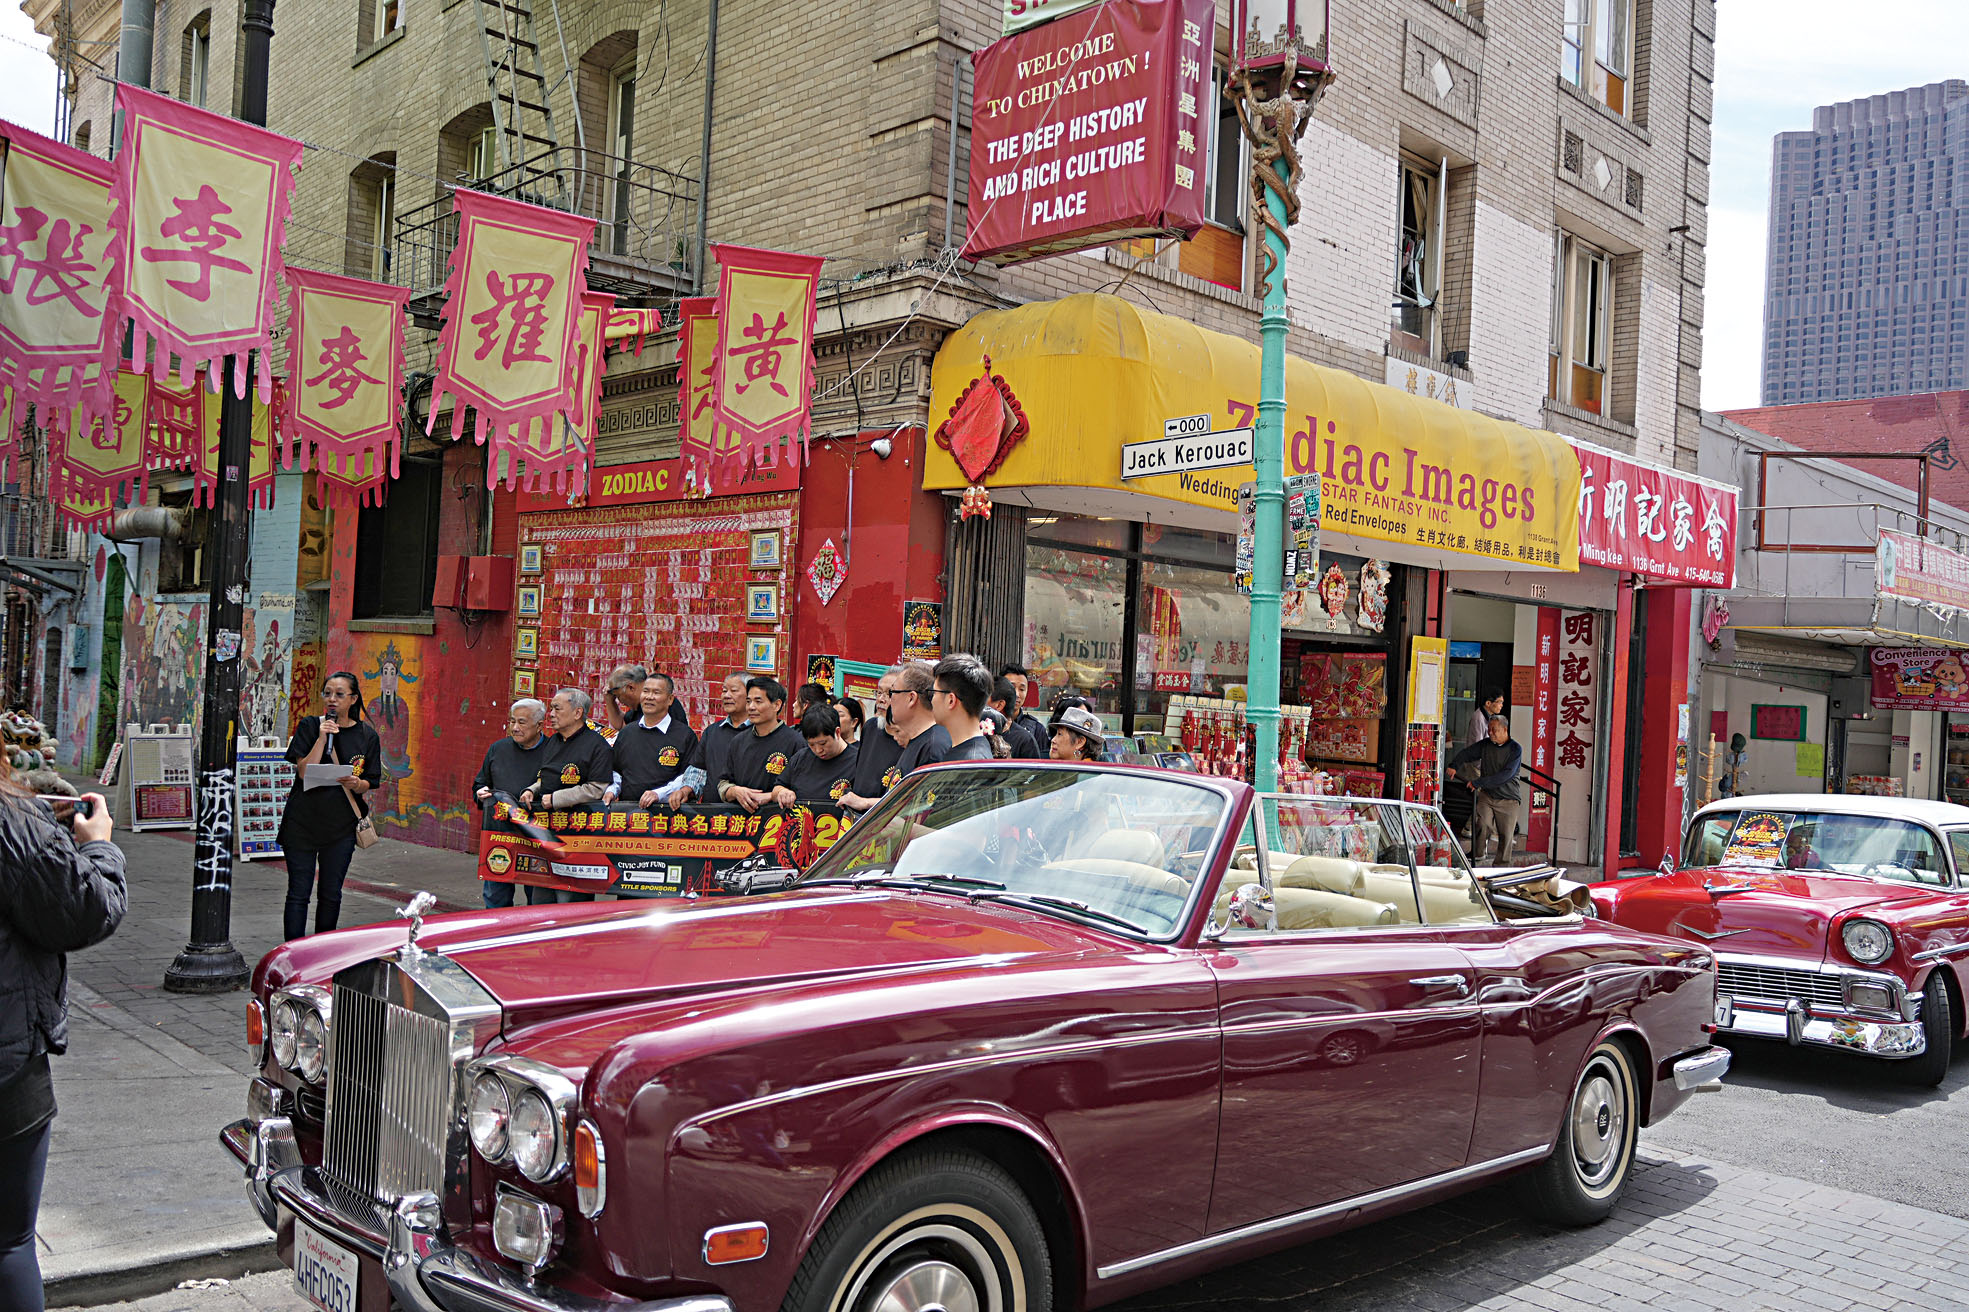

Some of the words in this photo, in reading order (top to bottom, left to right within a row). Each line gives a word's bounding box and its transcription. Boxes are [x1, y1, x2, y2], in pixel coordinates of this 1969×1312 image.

[1016, 32, 1115, 80] WELCOME
[987, 96, 1012, 118] TO
[1018, 55, 1137, 109] CHINATOWN
[987, 135, 1018, 164] THE
[1023, 121, 1064, 154] DEEP
[1069, 97, 1148, 142] HISTORY
[983, 172, 1018, 201] AND
[1022, 158, 1060, 192] RICH
[1065, 137, 1146, 180] CULTURE
[1031, 190, 1087, 226] PLACE
[140, 184, 253, 303] 李
[470, 270, 555, 370] 羅
[1128, 448, 1167, 470] Jack
[1175, 439, 1247, 464] Kerouac
[602, 469, 668, 497] ZODIAC
[1179, 473, 1239, 505] Wedding
[1402, 448, 1535, 529] Images
[1322, 483, 1357, 502] STAR
[1364, 491, 1422, 517] FANTASY
[1428, 507, 1452, 524] INC.
[1325, 504, 1348, 523] Red
[1351, 507, 1407, 535] Envelopes
[813, 548, 836, 580] 福
[1583, 542, 1605, 565] Ming
[1607, 548, 1623, 565] kee
[1632, 556, 1648, 571] 1136
[1649, 559, 1665, 575] Grnt
[1666, 562, 1680, 576] Ave
[1531, 584, 1547, 598] 1136
[1874, 649, 1947, 661] Convenience
[1902, 659, 1930, 667] Store
[1557, 612, 1593, 769] 明記家禽
[490, 834, 532, 847] PRESENTED
[532, 841, 542, 849] BY
[595, 841, 651, 850] ANNUAL
[679, 844, 747, 853] CHINATOWN
[617, 861, 636, 869] CIVIC
[640, 884, 678, 892] SPONSORS
[306, 1233, 345, 1272] California
[298, 1250, 351, 1312] 4HFC053
